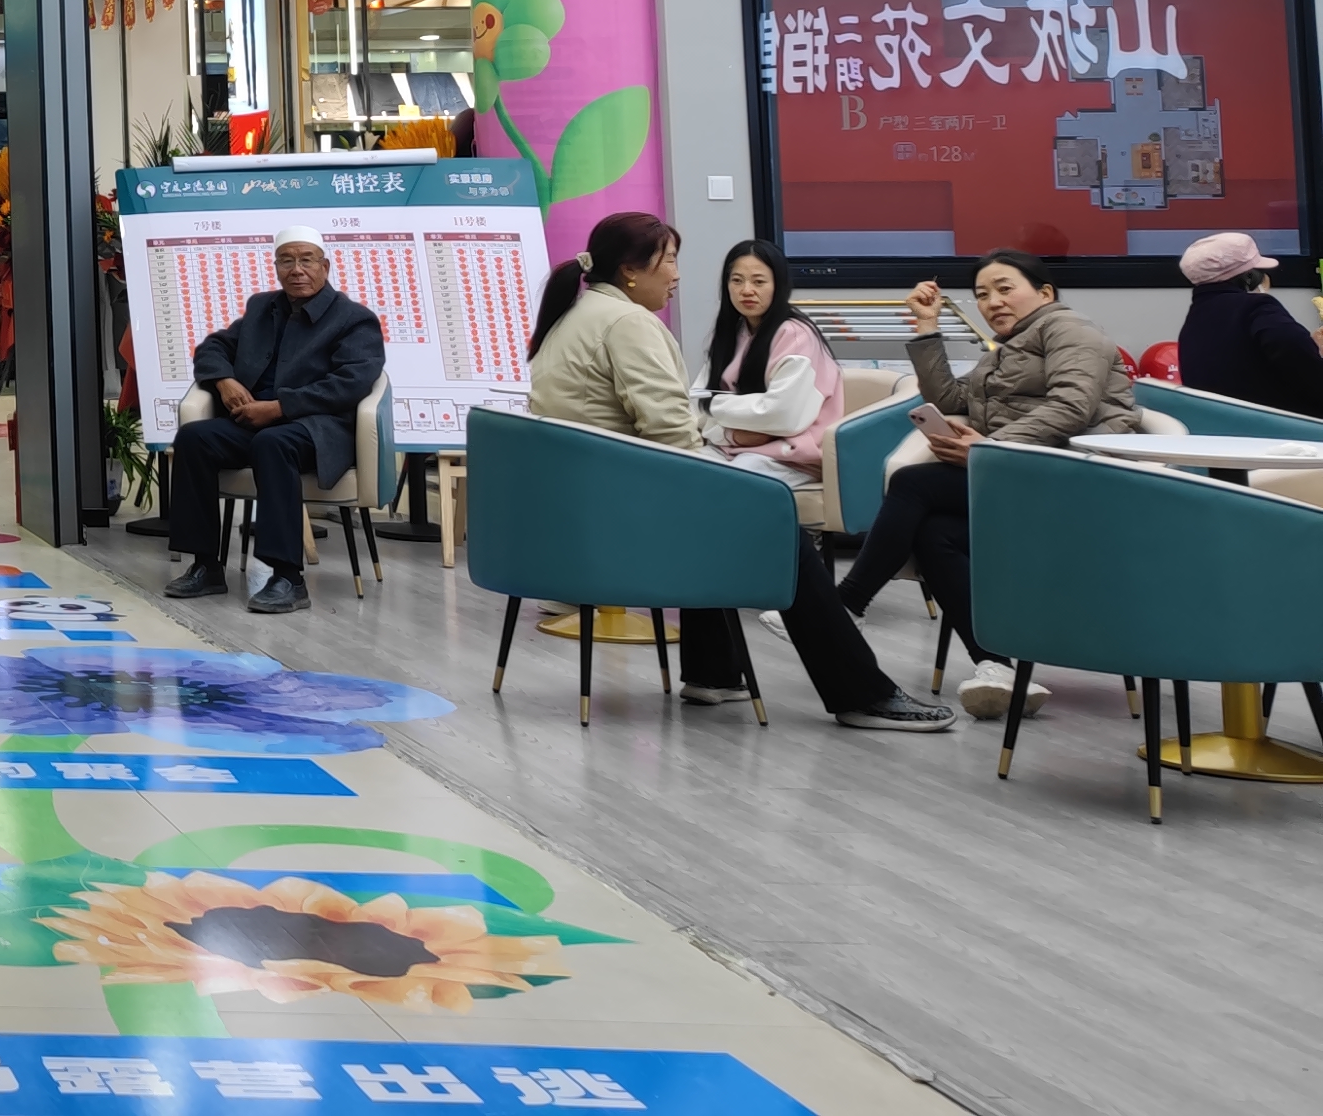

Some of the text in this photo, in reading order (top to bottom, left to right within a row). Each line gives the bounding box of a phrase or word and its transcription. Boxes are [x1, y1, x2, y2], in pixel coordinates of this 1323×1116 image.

[841, 95, 868, 131] B
[878, 113, 1008, 132] 户型 三室两厅一卫
[331, 171, 406, 195] 销控表
[194, 216, 487, 231] 7号楼 9号楼 11号楼
